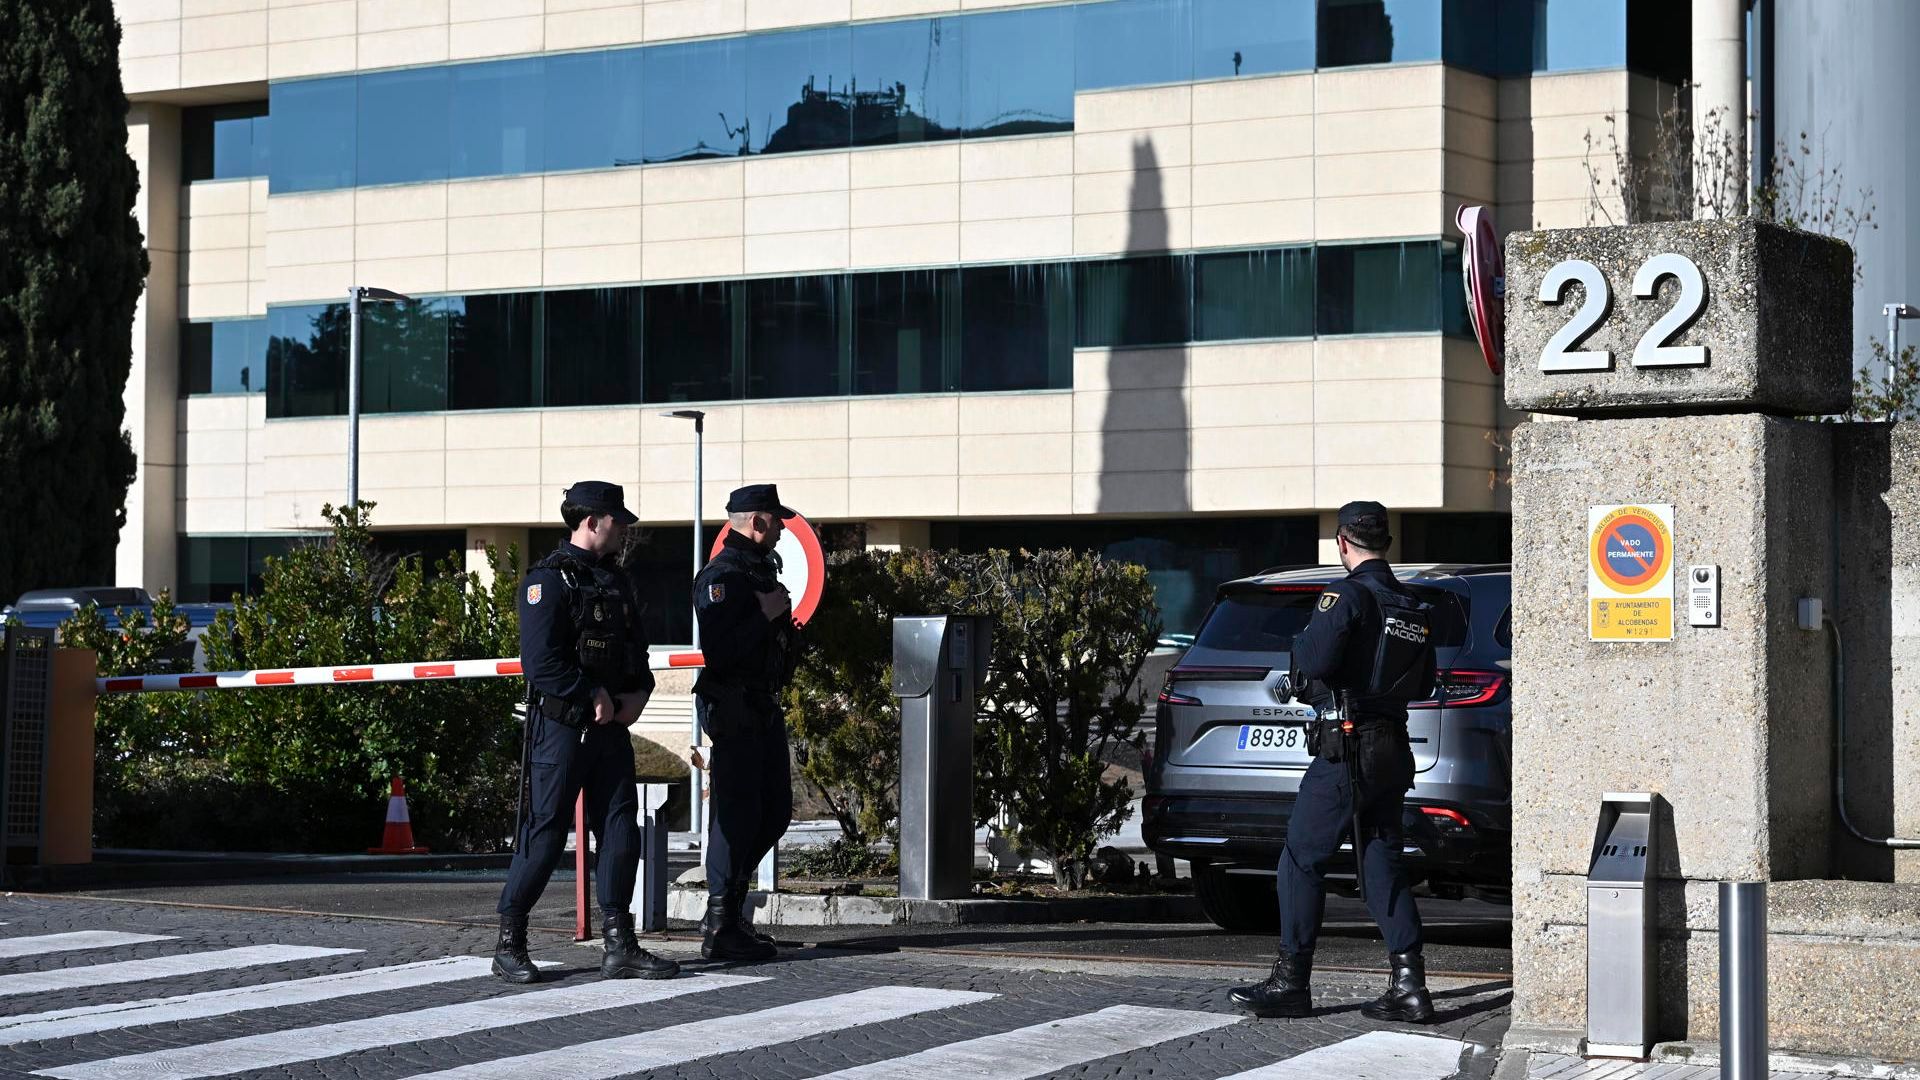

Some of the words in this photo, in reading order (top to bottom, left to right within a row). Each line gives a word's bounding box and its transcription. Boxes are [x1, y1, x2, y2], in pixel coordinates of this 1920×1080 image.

[1538, 252, 1708, 373] 22
[1594, 513, 1615, 534] SALIDA
[1618, 508, 1628, 516] DE
[1620, 539, 1641, 547] VADO
[1607, 550, 1655, 558] PERMANENTE
[1615, 601, 1660, 609] AYUNTAMIENTO
[1633, 609, 1642, 617] DE
[1617, 618, 1659, 626] ALCOBENDAS
[1384, 625, 1426, 644] NACIONA
[1250, 728, 1298, 748] 8938
